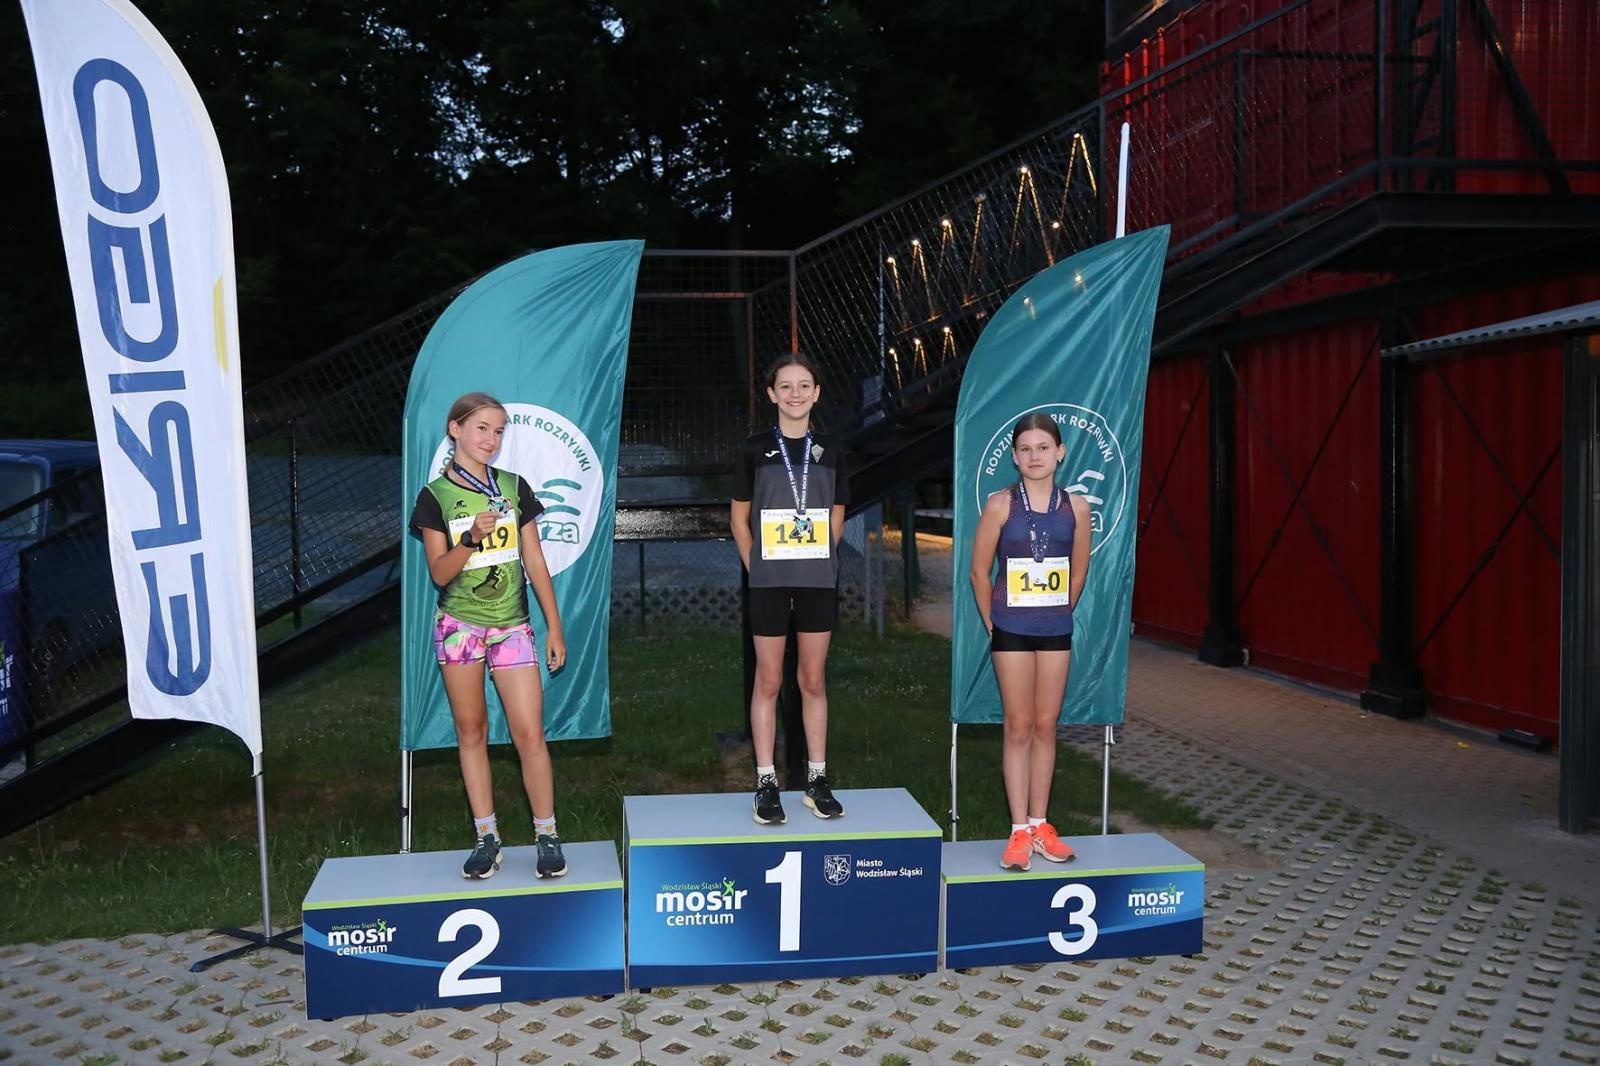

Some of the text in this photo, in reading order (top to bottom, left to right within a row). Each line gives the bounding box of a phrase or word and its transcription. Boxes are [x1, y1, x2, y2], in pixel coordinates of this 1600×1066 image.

[1050, 413, 1066, 424] RK
[506, 414, 592, 472] ARK ROZRYWKI
[486, 526, 508, 550] 19
[856, 859, 883, 867] Miasto
[856, 866, 923, 878] Wodzisław Śląski
[661, 881, 722, 891] Wodzisław Śląski
[656, 888, 748, 913] mosir
[765, 851, 801, 951] 1
[1128, 890, 1184, 907] mosir
[666, 912, 734, 926] centrum
[1048, 883, 1099, 956] 3
[1134, 906, 1176, 916] centrum
[328, 926, 397, 947] mosir
[336, 944, 388, 956] centrum
[437, 908, 501, 998] 2
